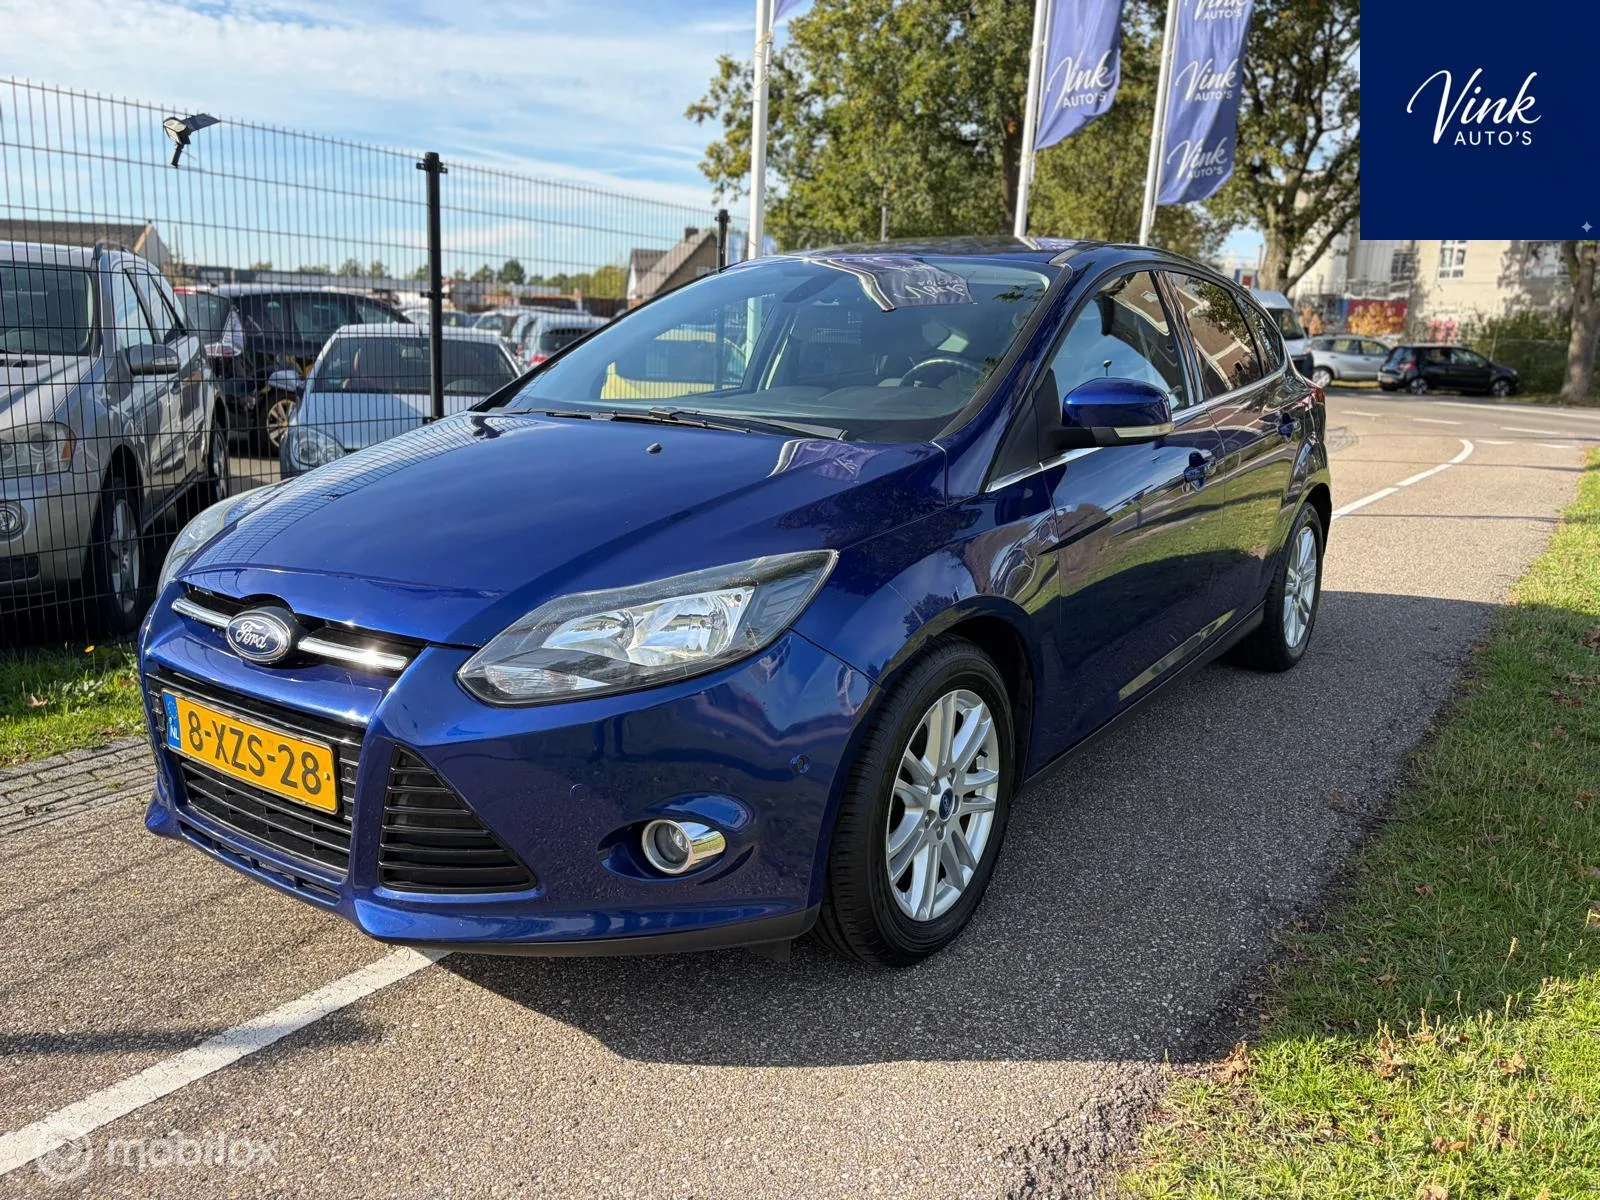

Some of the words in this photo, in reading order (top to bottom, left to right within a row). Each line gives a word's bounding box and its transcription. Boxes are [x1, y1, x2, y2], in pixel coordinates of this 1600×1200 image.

[1047, 49, 1113, 110] Vink
[1175, 58, 1239, 101] Vink
[1194, 90, 1233, 102] AUTO'S
[1166, 137, 1228, 179] Vink
[235, 620, 271, 650] Ford
[170, 726, 180, 741] NL
[187, 710, 322, 796] 8-XZS-28
